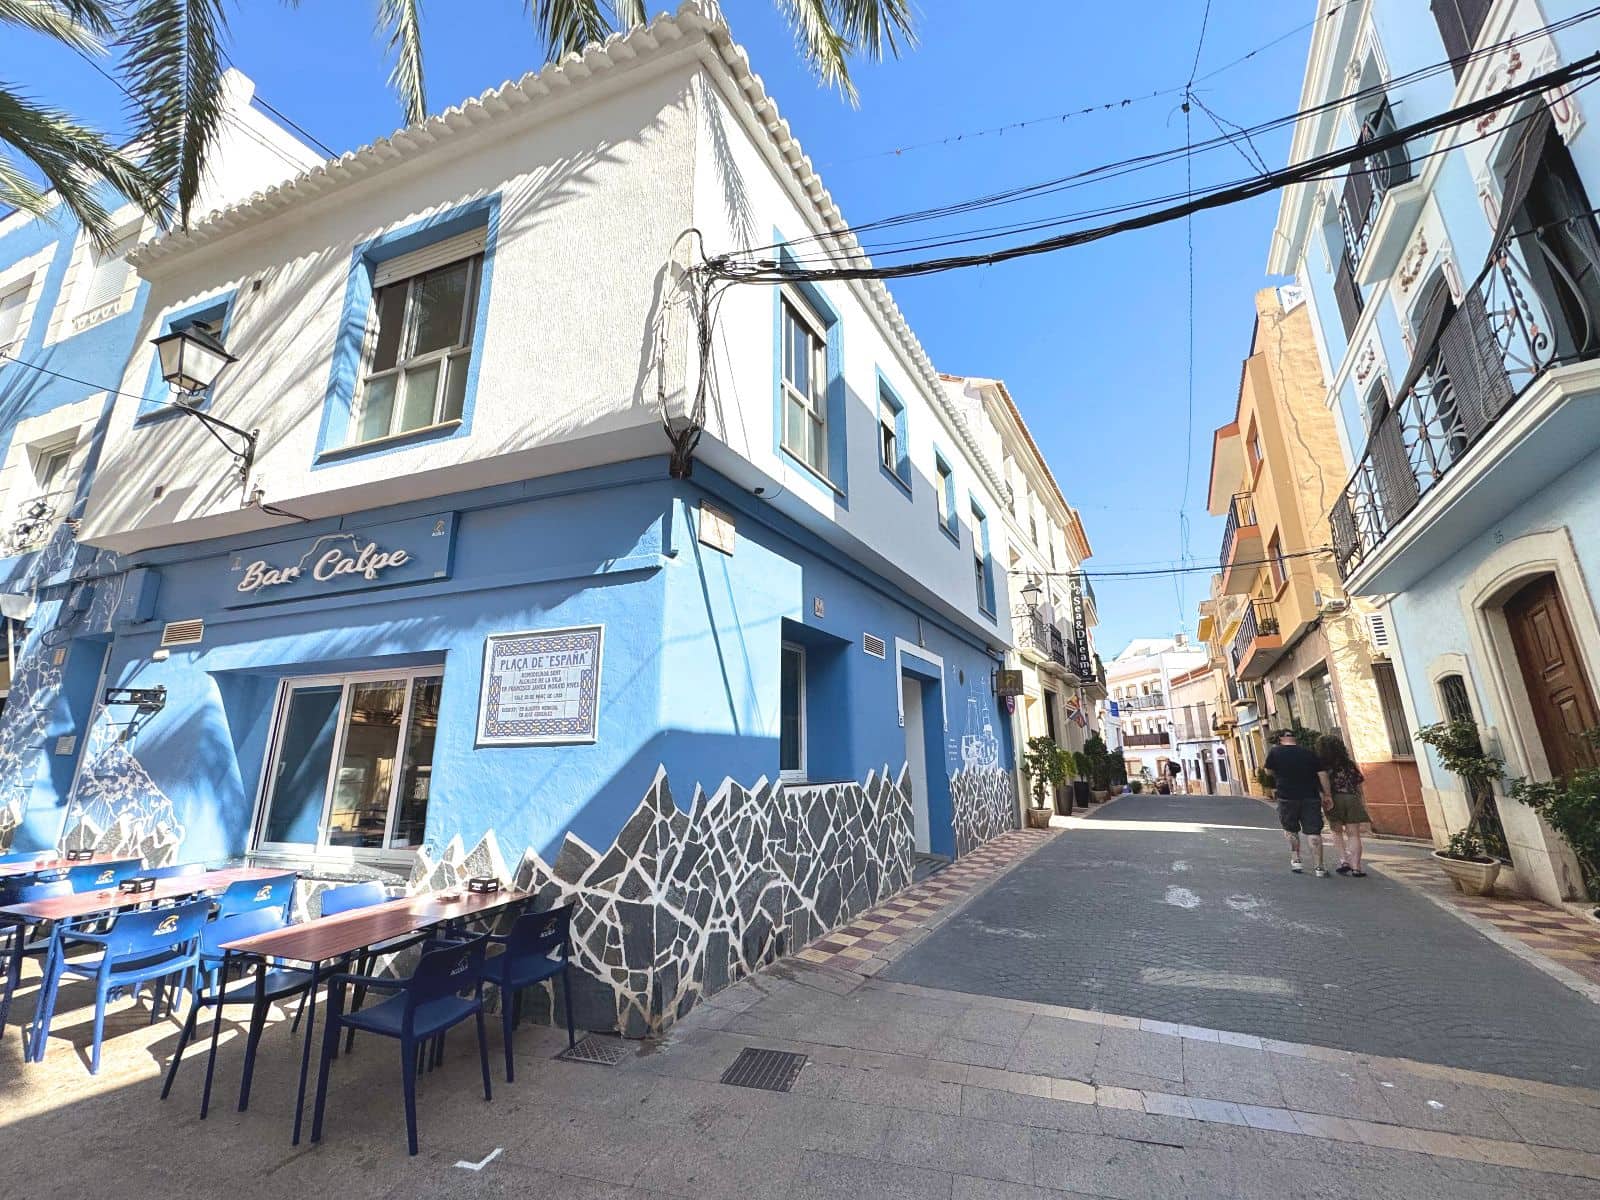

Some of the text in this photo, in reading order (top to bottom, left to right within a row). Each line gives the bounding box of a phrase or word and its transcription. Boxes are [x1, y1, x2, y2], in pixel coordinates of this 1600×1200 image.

[237, 542, 409, 593] Bar Calpe
[500, 657, 528, 673] PLAÇA
[532, 656, 544, 668] DE
